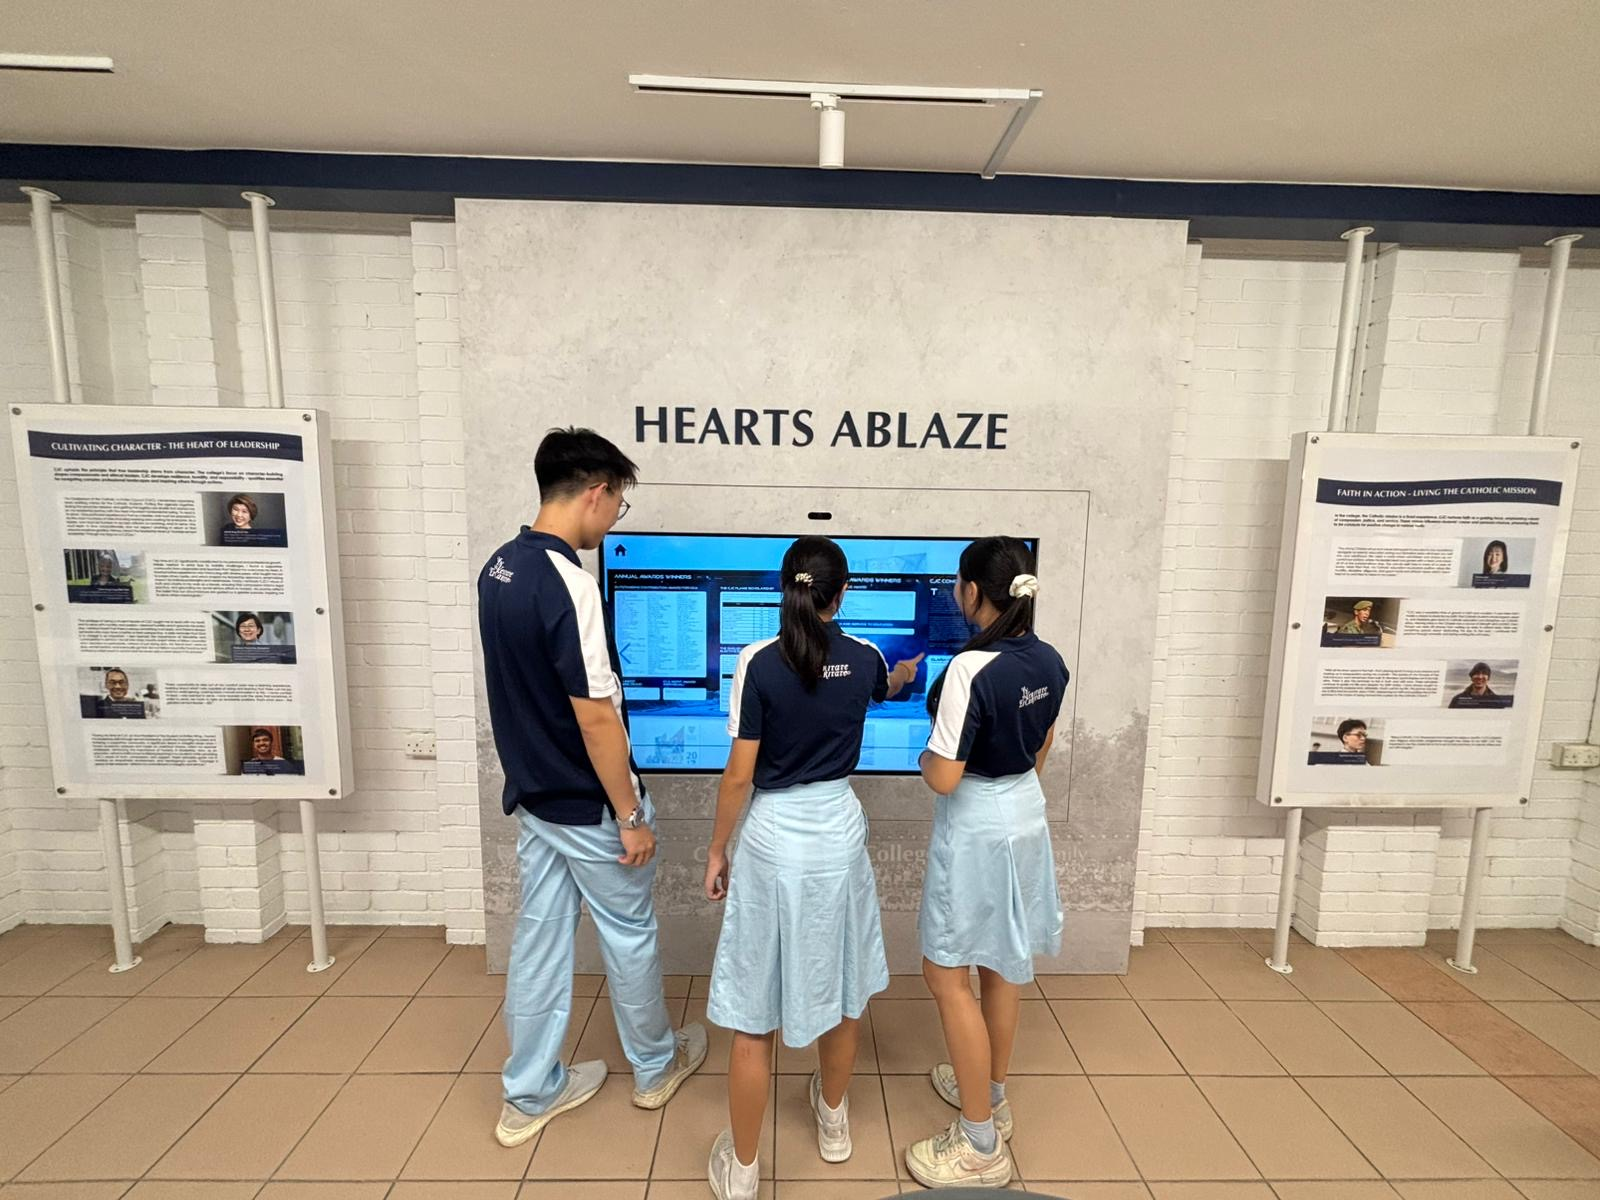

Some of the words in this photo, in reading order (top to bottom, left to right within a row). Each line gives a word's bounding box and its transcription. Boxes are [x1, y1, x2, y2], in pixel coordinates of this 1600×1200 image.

[635, 406, 814, 448] HEARTS
[830, 410, 1008, 450] ABLAZE
[51, 442, 110, 452] CULTIVATING
[110, 442, 162, 452] CHARACTER
[168, 441, 185, 450] THE
[186, 440, 214, 449] HEART
[215, 440, 228, 449] OF
[230, 440, 280, 450] LEADERSHIP
[1336, 488, 1361, 497] FAITH
[1362, 489, 1373, 498] IN
[1373, 489, 1406, 498] ACTION
[1413, 488, 1441, 497] LIVING
[1443, 487, 1459, 496] THE
[1460, 486, 1502, 495] CATHOLIC
[1502, 486, 1537, 495] MISSION
[871, 844, 929, 866] olleg
